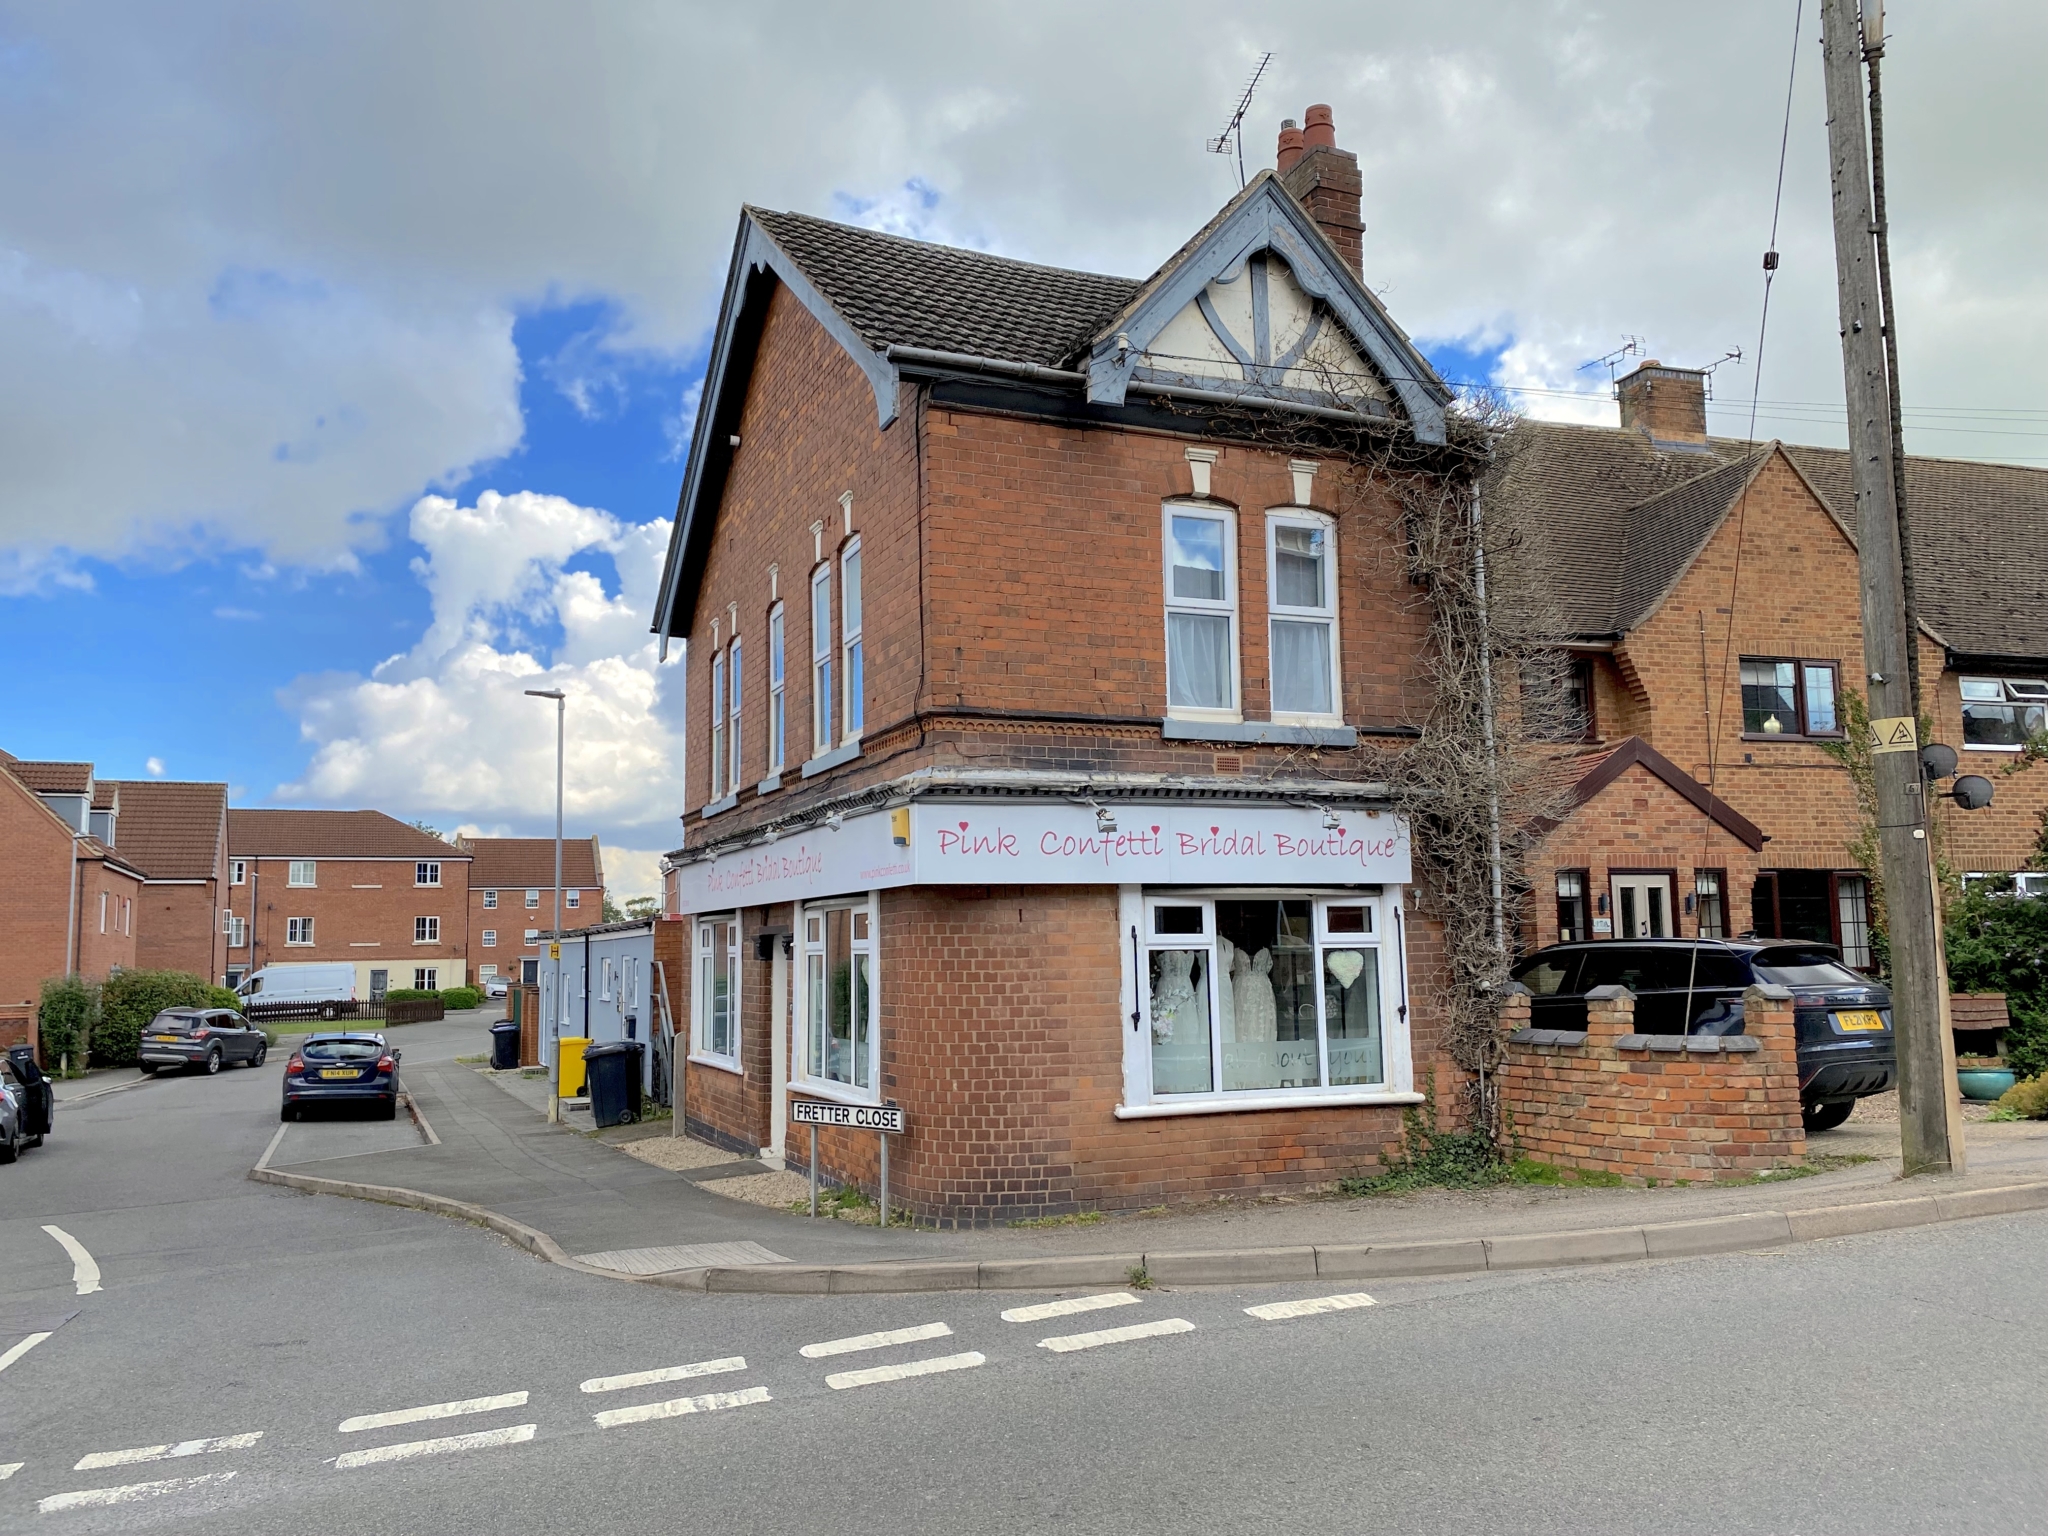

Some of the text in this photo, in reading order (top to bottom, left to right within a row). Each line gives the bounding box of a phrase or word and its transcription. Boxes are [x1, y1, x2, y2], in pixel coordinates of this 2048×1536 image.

[937, 821, 1395, 867] Pink Confetti Bridal Boutique
[756, 854, 780, 884] Bridal
[782, 845, 822, 885] Boutique
[796, 1104, 898, 1128] FRETTER CLOSE
